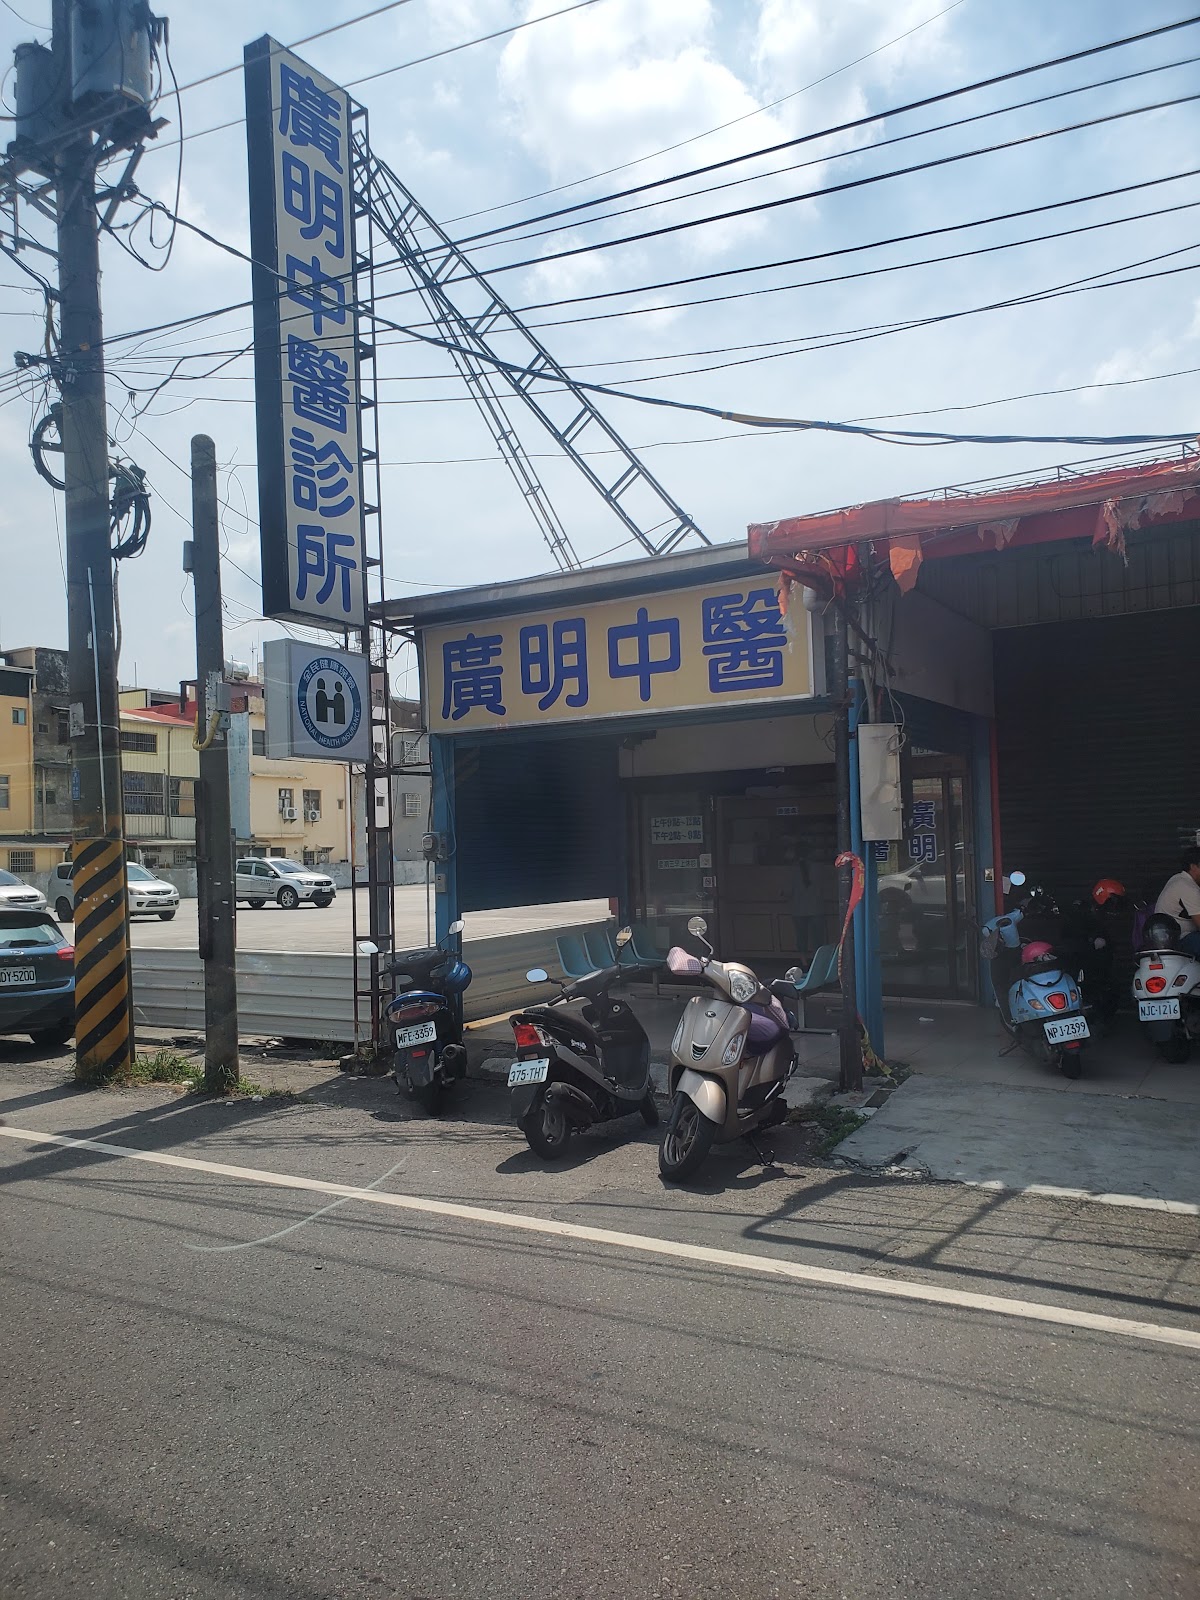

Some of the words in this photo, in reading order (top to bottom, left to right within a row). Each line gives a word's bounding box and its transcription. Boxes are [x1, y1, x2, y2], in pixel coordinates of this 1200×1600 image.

[278, 62, 356, 612] 廣明中醫診所
[441, 587, 788, 721] 廣明中醫
[303, 659, 356, 690] 全民健康保險
[300, 701, 318, 738] NATIONAL
[319, 735, 341, 747] HEALTH
[342, 708, 361, 743] INSURANCE
[0, 970, 35, 982] DY-5200
[1140, 1004, 1179, 1017] NJC-1216
[397, 1026, 434, 1044] MFE-3359
[1046, 1021, 1086, 1039] NPJ-2399
[509, 1066, 547, 1083] 375-THT
